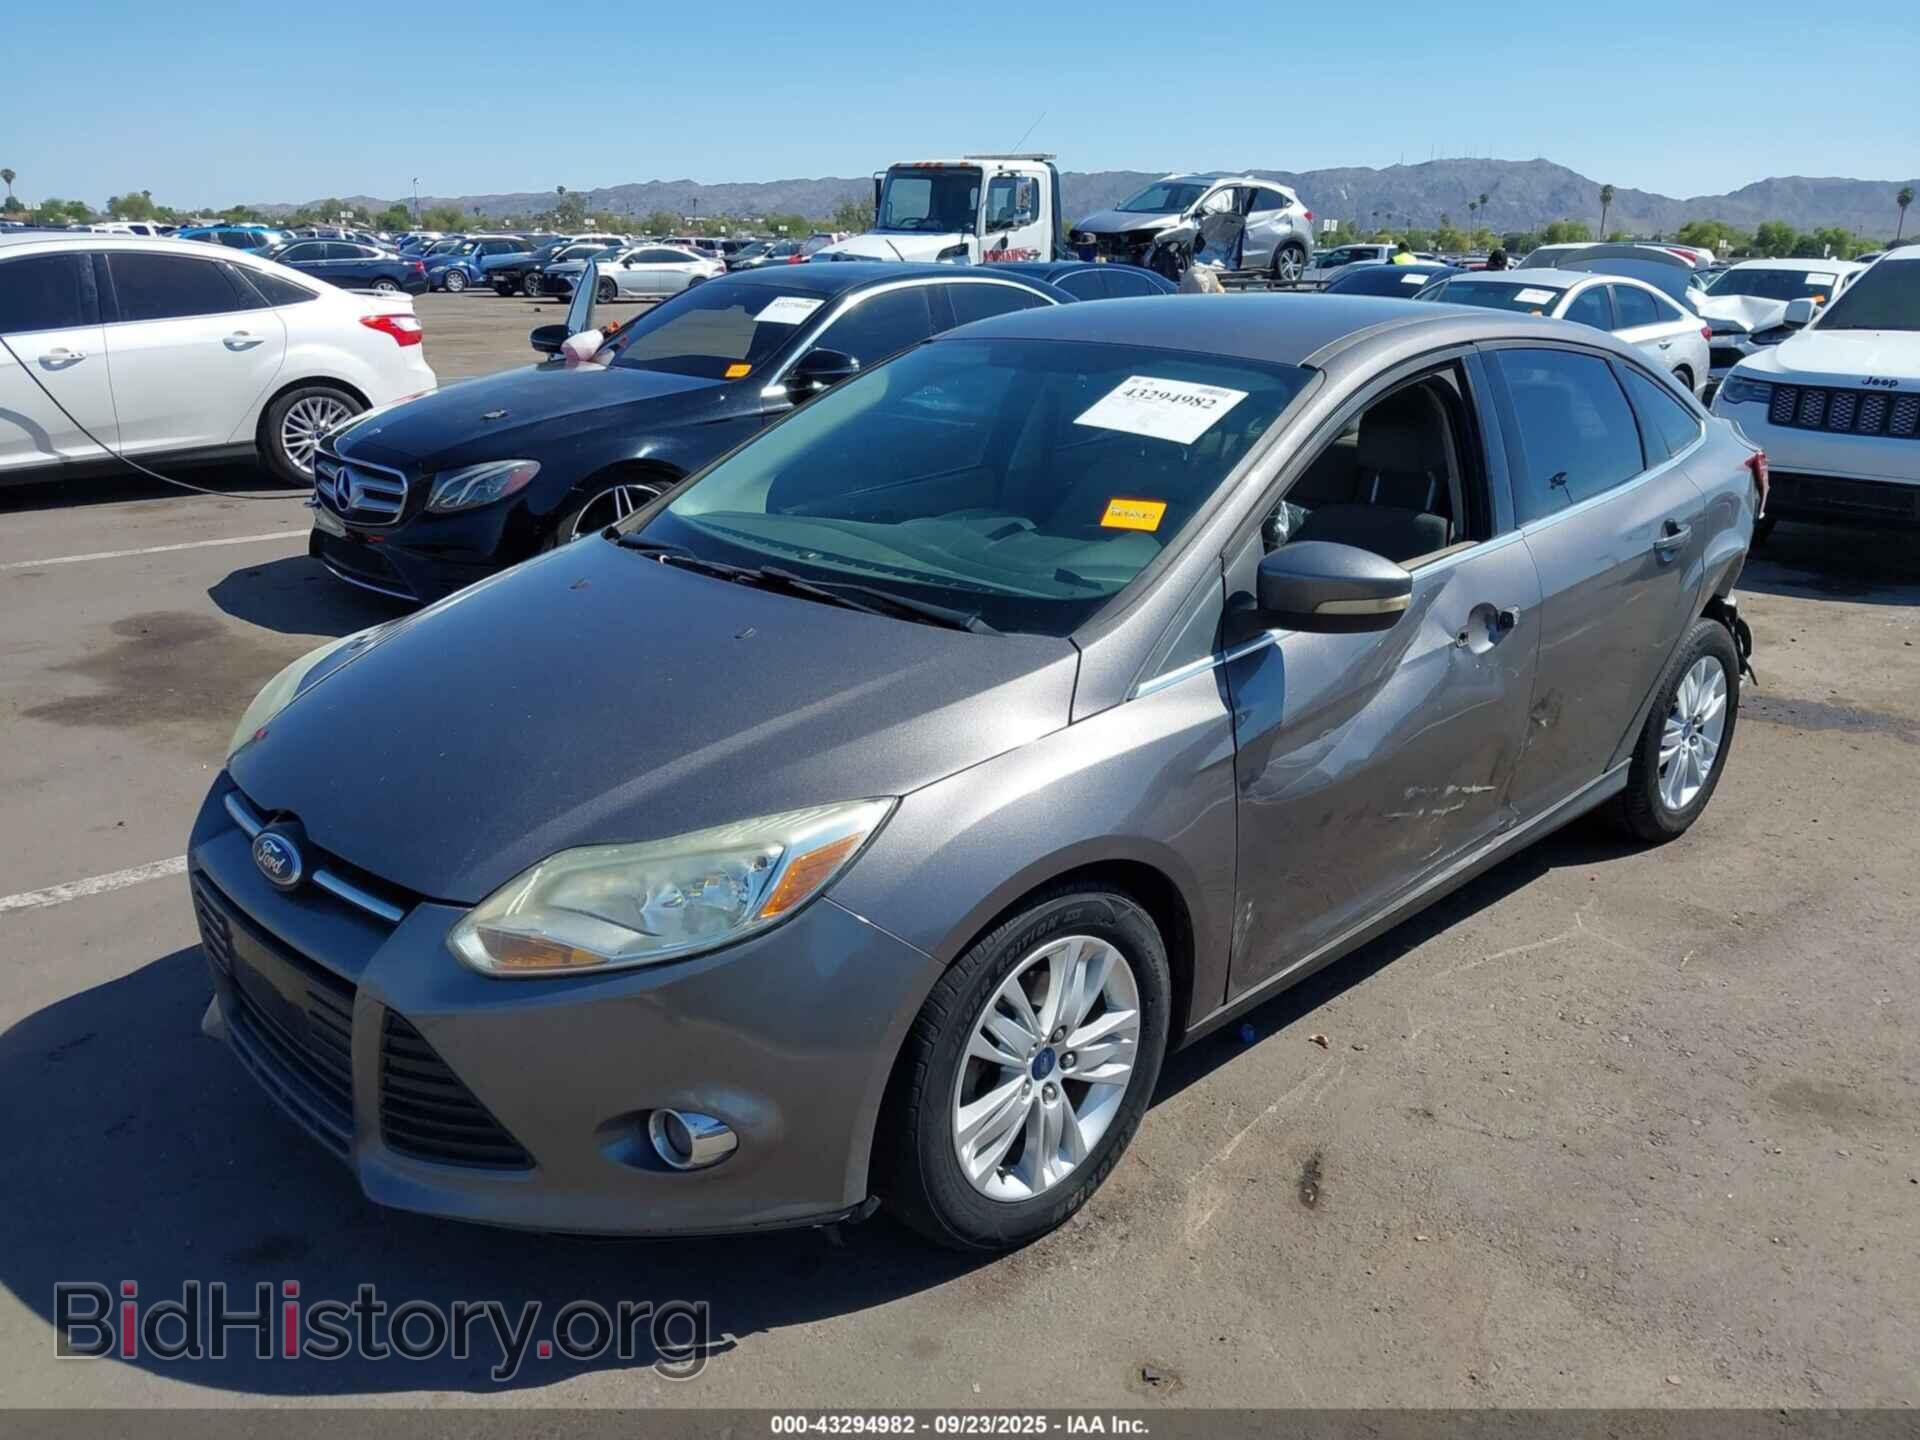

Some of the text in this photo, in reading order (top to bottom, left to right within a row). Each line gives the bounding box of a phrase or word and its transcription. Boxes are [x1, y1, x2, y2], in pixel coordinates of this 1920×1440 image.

[1862, 376, 1899, 388] Jeep
[1123, 387, 1218, 410] 43294982
[257, 839, 286, 874] Ford
